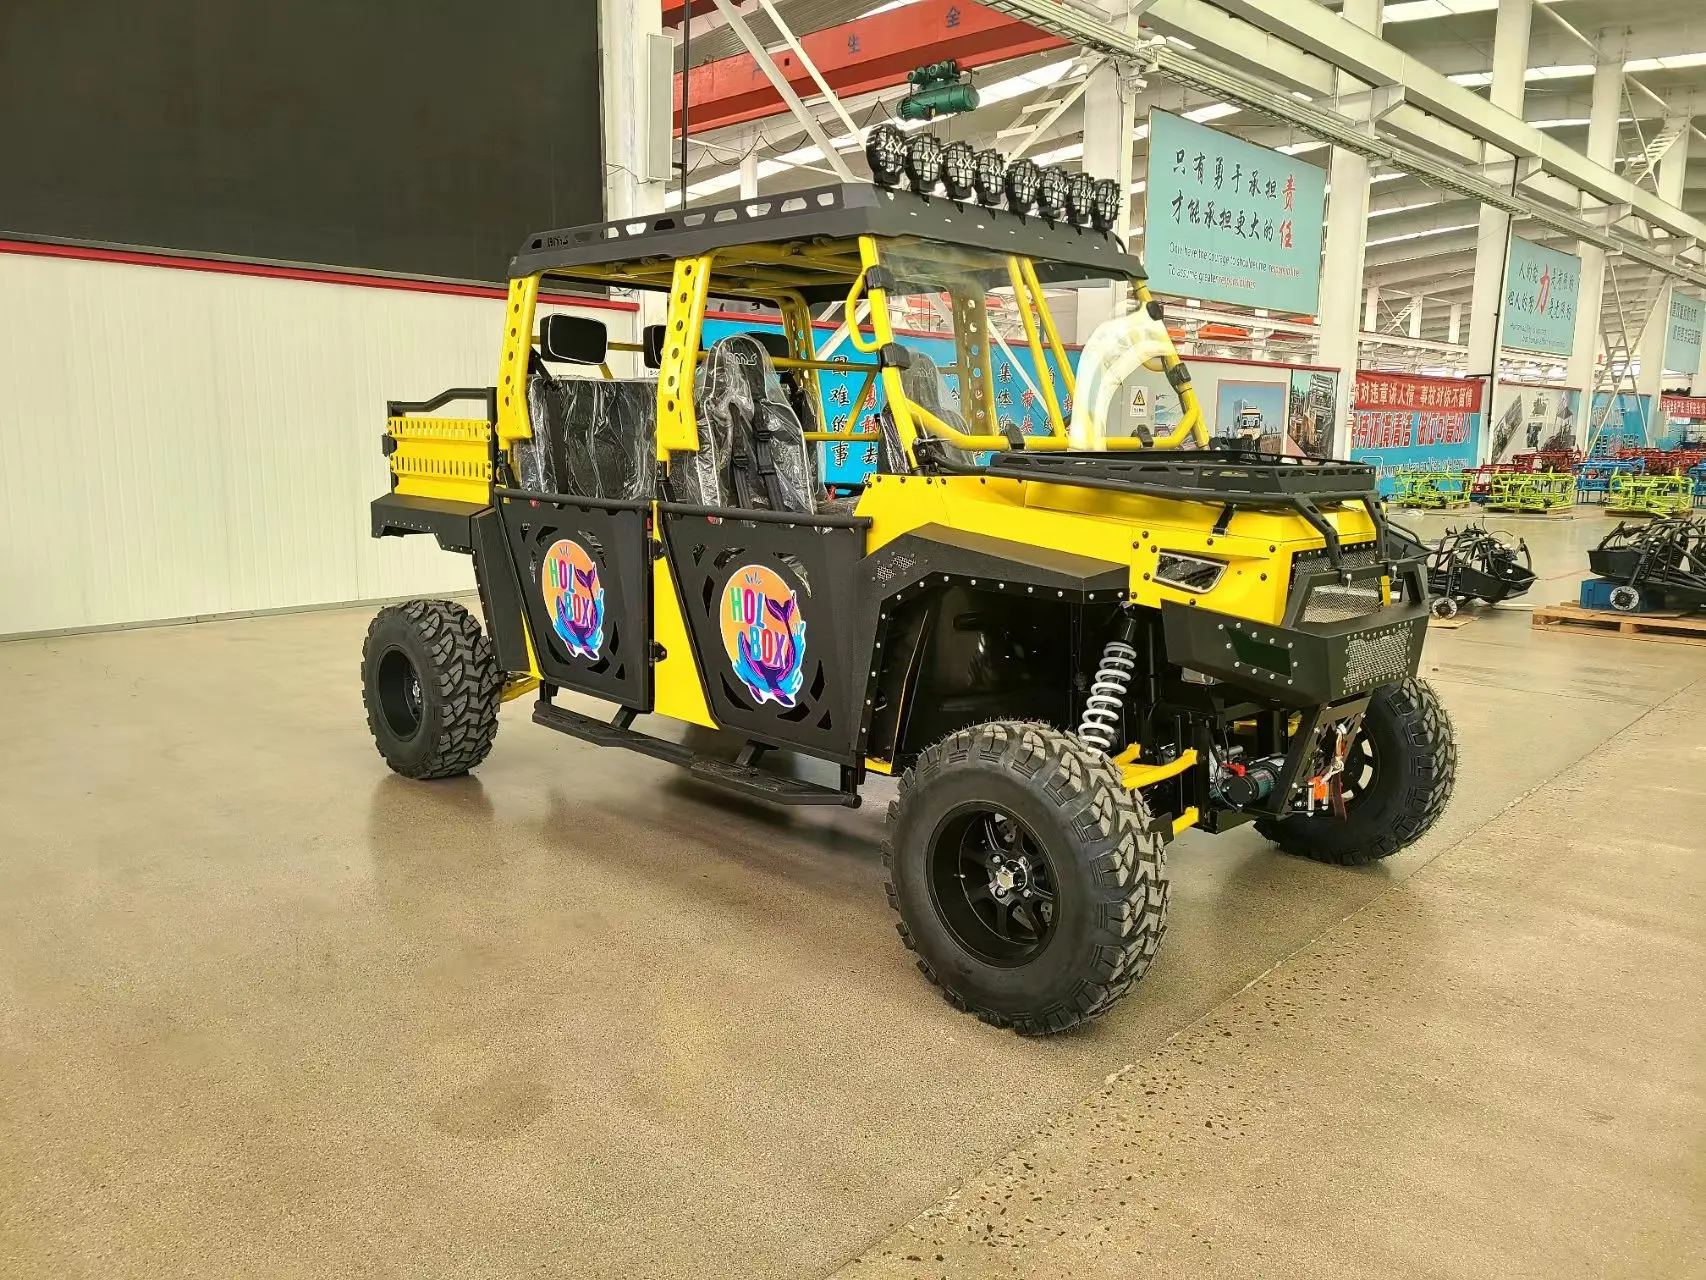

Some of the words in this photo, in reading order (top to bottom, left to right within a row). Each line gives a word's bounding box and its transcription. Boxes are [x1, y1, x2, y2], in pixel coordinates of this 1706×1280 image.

[921, 150, 944, 165] 4X4
[956, 158, 978, 171] 4X4
[988, 164, 1007, 178] 4X4
[1022, 176, 1041, 189] 4X4
[1052, 181, 1070, 195] 4X4
[1080, 188, 1097, 200] 4X4
[1198, 271, 1218, 283] greater
[549, 557, 575, 594] HOL
[563, 591, 591, 628] BOX
[730, 587, 766, 629] HOL
[749, 626, 786, 669] BOX
